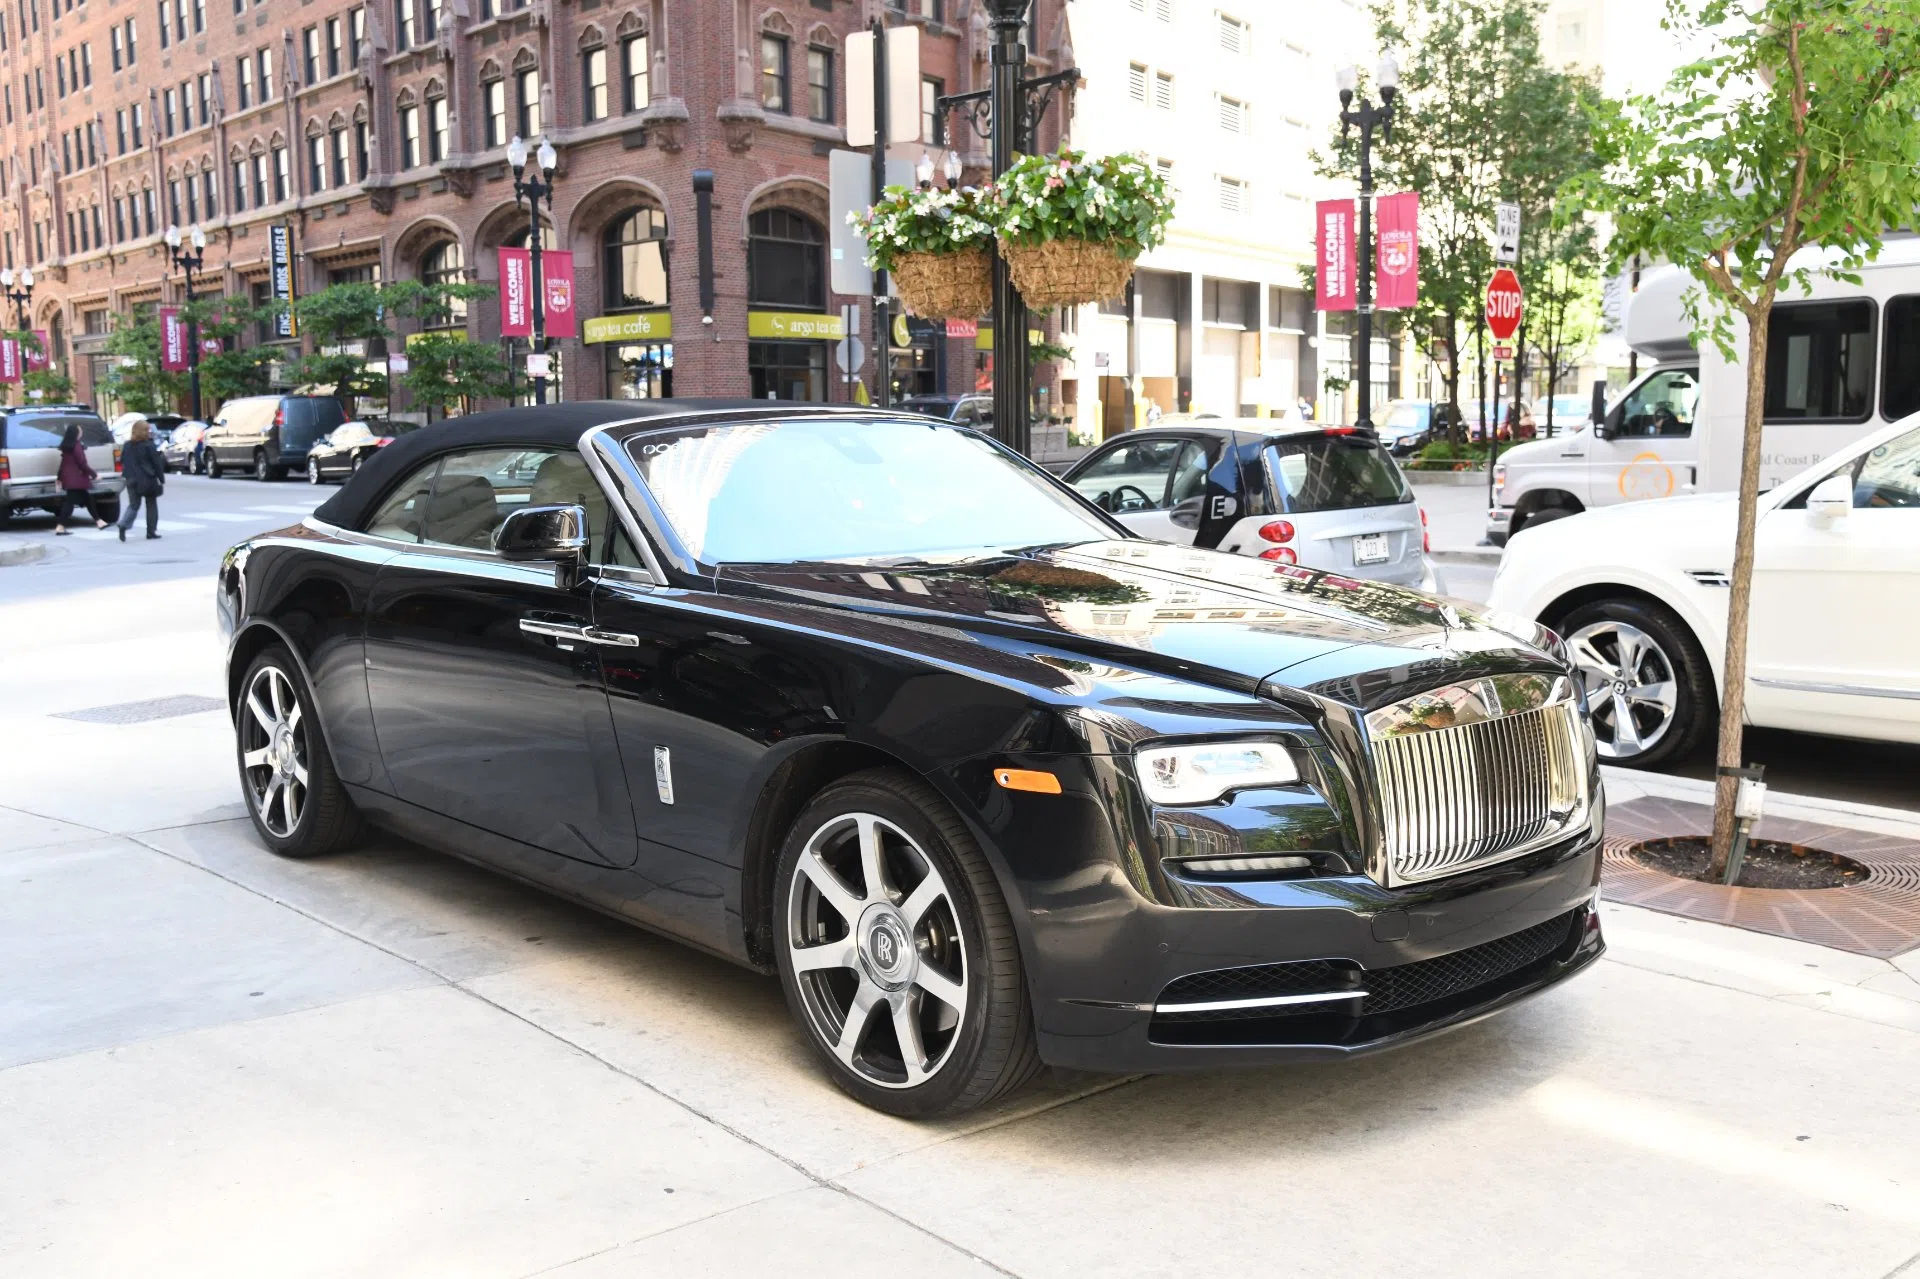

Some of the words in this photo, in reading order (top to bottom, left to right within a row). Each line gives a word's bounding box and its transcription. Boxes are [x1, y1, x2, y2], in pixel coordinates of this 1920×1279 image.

[1500, 208, 1517, 224] ONE
[1381, 231, 1412, 240] LOYOLA
[1500, 226, 1517, 237] WAY
[273, 227, 288, 264] BAGELS
[1325, 212, 1338, 298] WELCOME
[507, 257, 519, 326] WELCOME
[278, 292, 292, 335] EINSN
[1487, 290, 1520, 319] STOP
[624, 315, 651, 334] café
[790, 320, 815, 337] argo
[816, 319, 829, 334] tea
[166, 315, 177, 363] WELCOME
[1774, 453, 1808, 465] Coast
